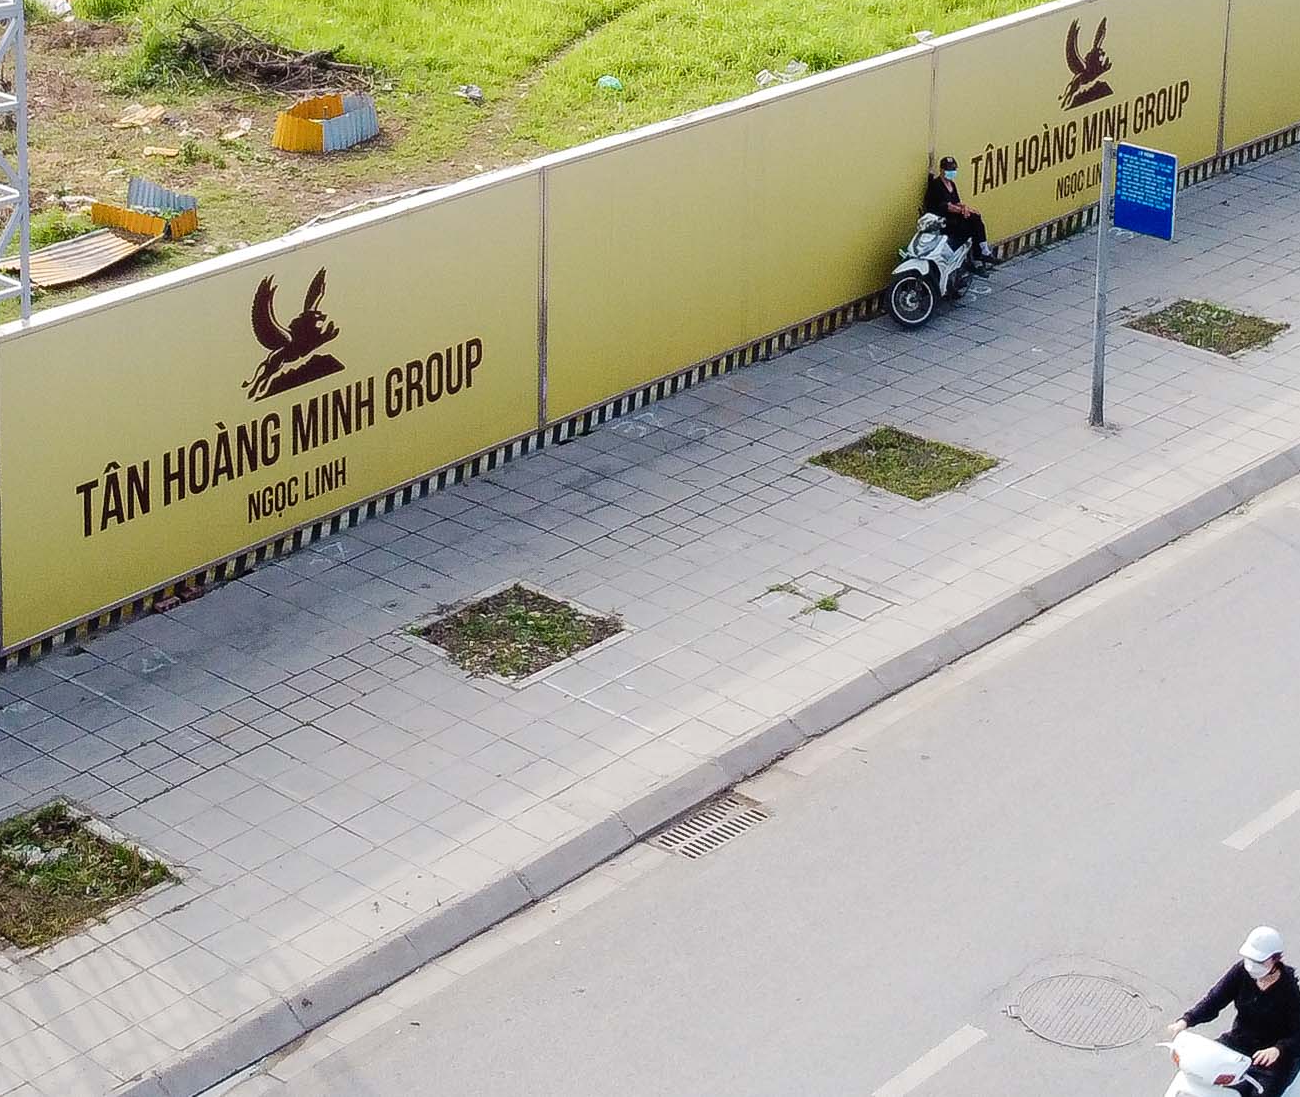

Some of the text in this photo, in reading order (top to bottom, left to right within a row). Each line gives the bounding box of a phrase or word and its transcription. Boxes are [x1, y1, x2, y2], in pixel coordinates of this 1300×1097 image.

[970, 143, 1009, 197] TÂN
[1013, 122, 1077, 181] HOÀNG
[1081, 103, 1129, 155] MINH
[1132, 79, 1190, 135] GROUP
[1056, 168, 1084, 201] NGỌC
[75, 336, 483, 538] TÂN HOÀNG MINH GROUP
[247, 455, 347, 524] NGỌC LINH
